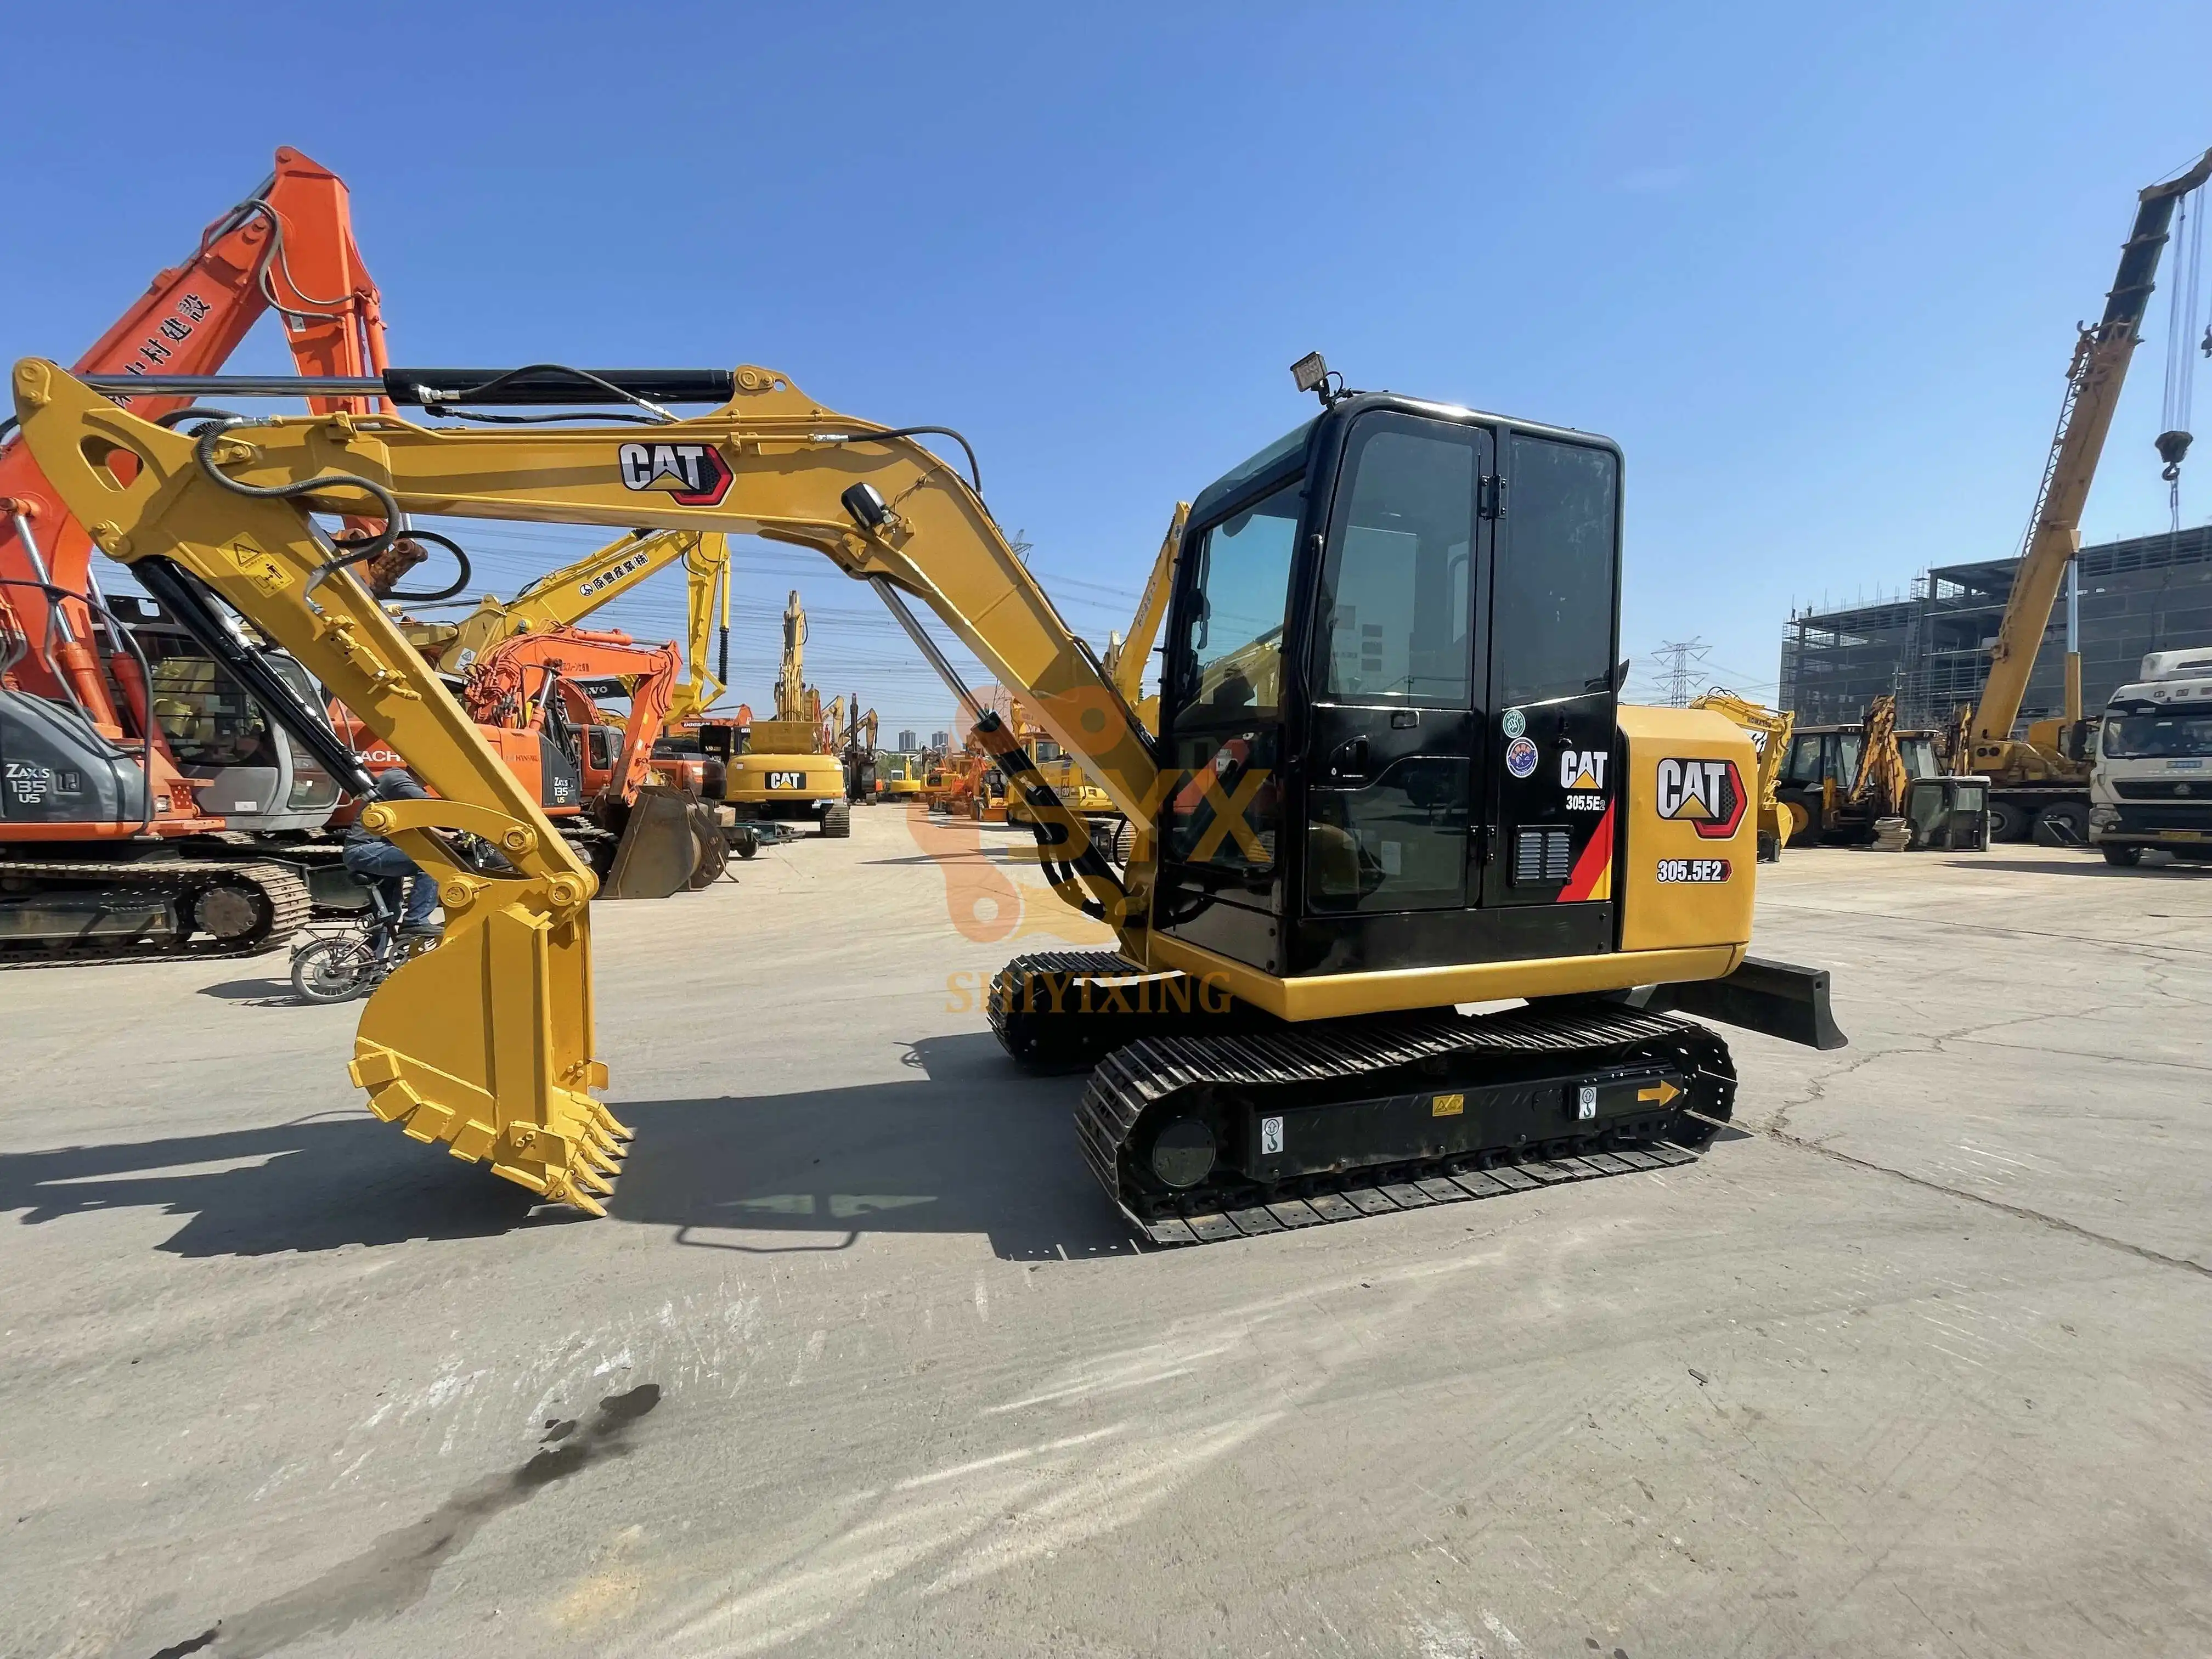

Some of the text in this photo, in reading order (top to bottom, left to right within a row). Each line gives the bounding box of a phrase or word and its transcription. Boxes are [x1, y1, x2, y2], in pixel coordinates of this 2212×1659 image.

[620, 444, 703, 490] CAT
[1561, 751, 1608, 789] CAT
[10, 780, 47, 793] 135
[771, 772, 800, 789] CAT
[1658, 759, 1725, 818] CAT
[19, 793, 41, 803] US
[554, 787, 568, 796] 135
[1657, 860, 1722, 881] 305.5E2
